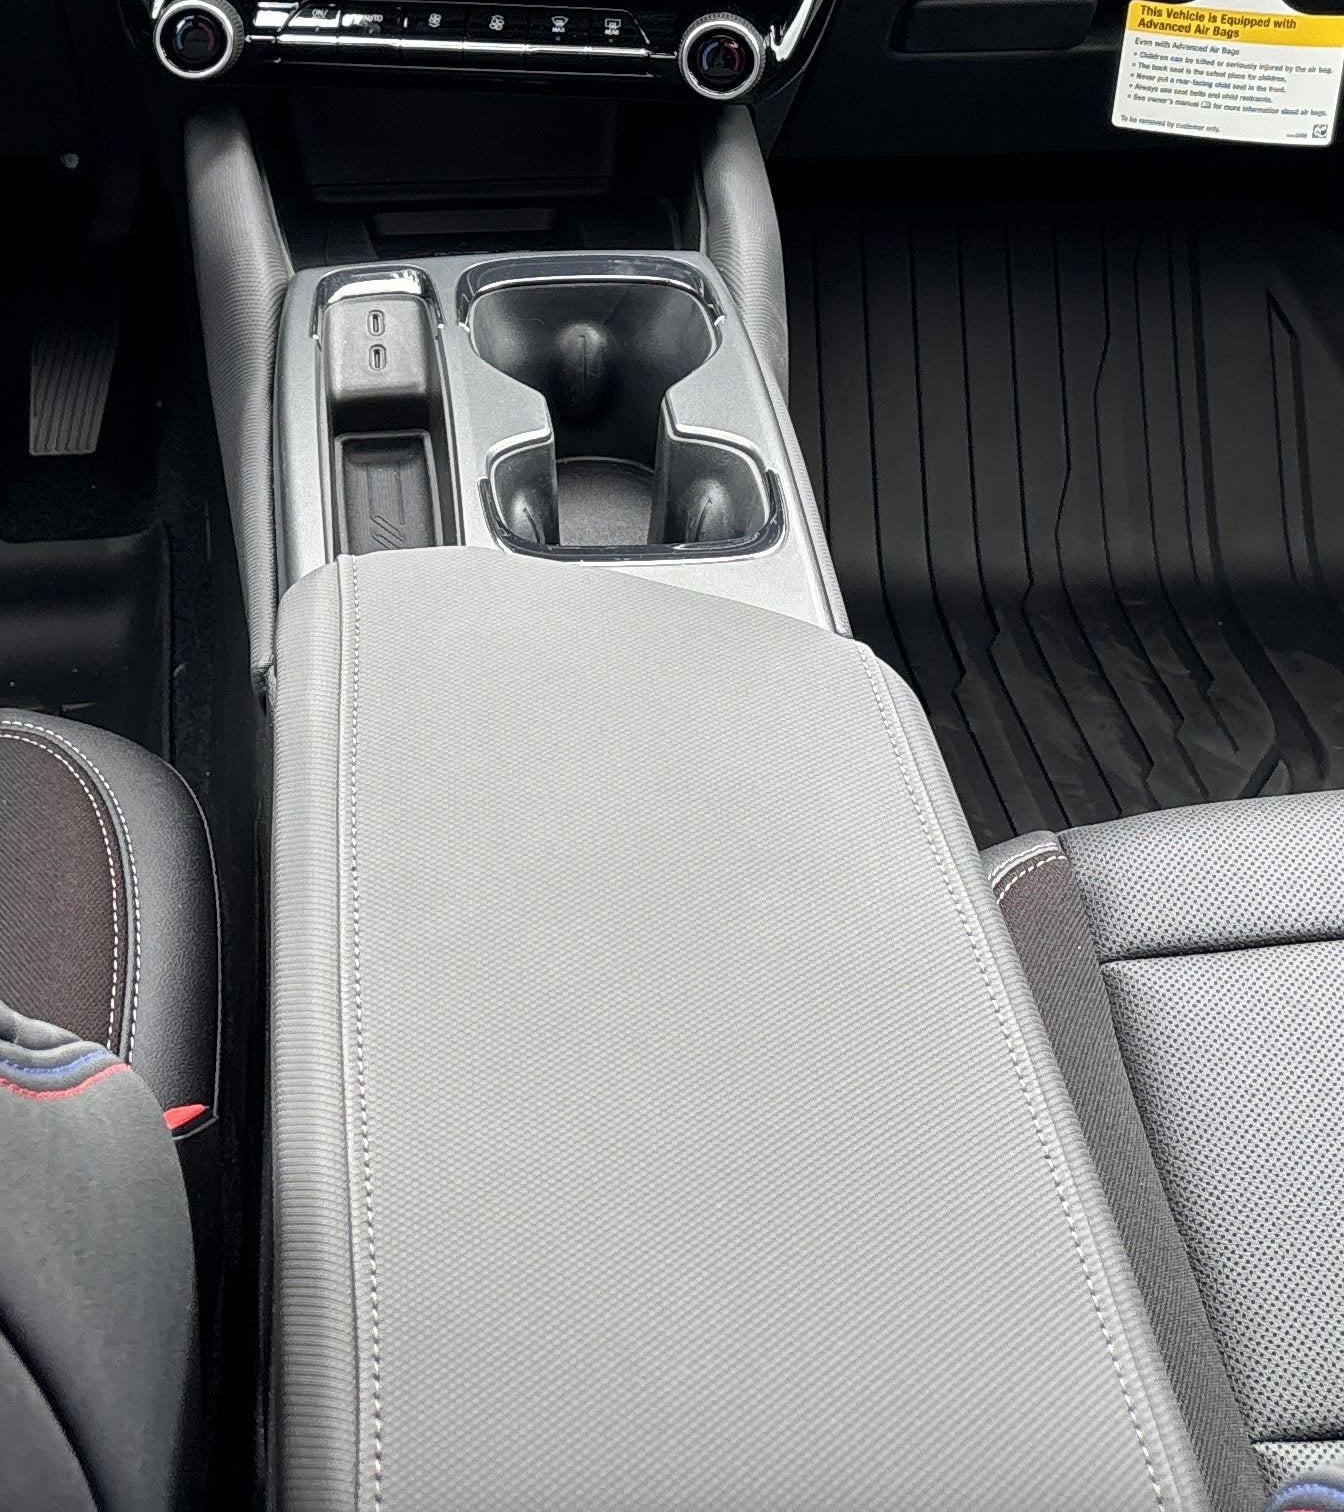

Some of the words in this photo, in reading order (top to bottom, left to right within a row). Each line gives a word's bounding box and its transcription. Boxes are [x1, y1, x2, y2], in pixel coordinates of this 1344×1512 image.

[1140, 5, 1163, 17] This
[1166, 8, 1205, 23] Vehicle
[1208, 14, 1217, 24] is
[1221, 14, 1270, 28] Equipped
[1274, 19, 1297, 29] with
[1138, 18, 1192, 33] Advanced
[1194, 27, 1210, 36] Air
[1213, 28, 1240, 39] Bags
[1172, 42, 1208, 52] Advanced
[1209, 46, 1220, 54] Air
[1221, 47, 1240, 56] Bags
[1138, 62, 1151, 70] The
[1226, 61, 1257, 71] seriously
[1259, 63, 1284, 72] injured
[1285, 65, 1294, 73] by
[1136, 72, 1156, 81] Never
